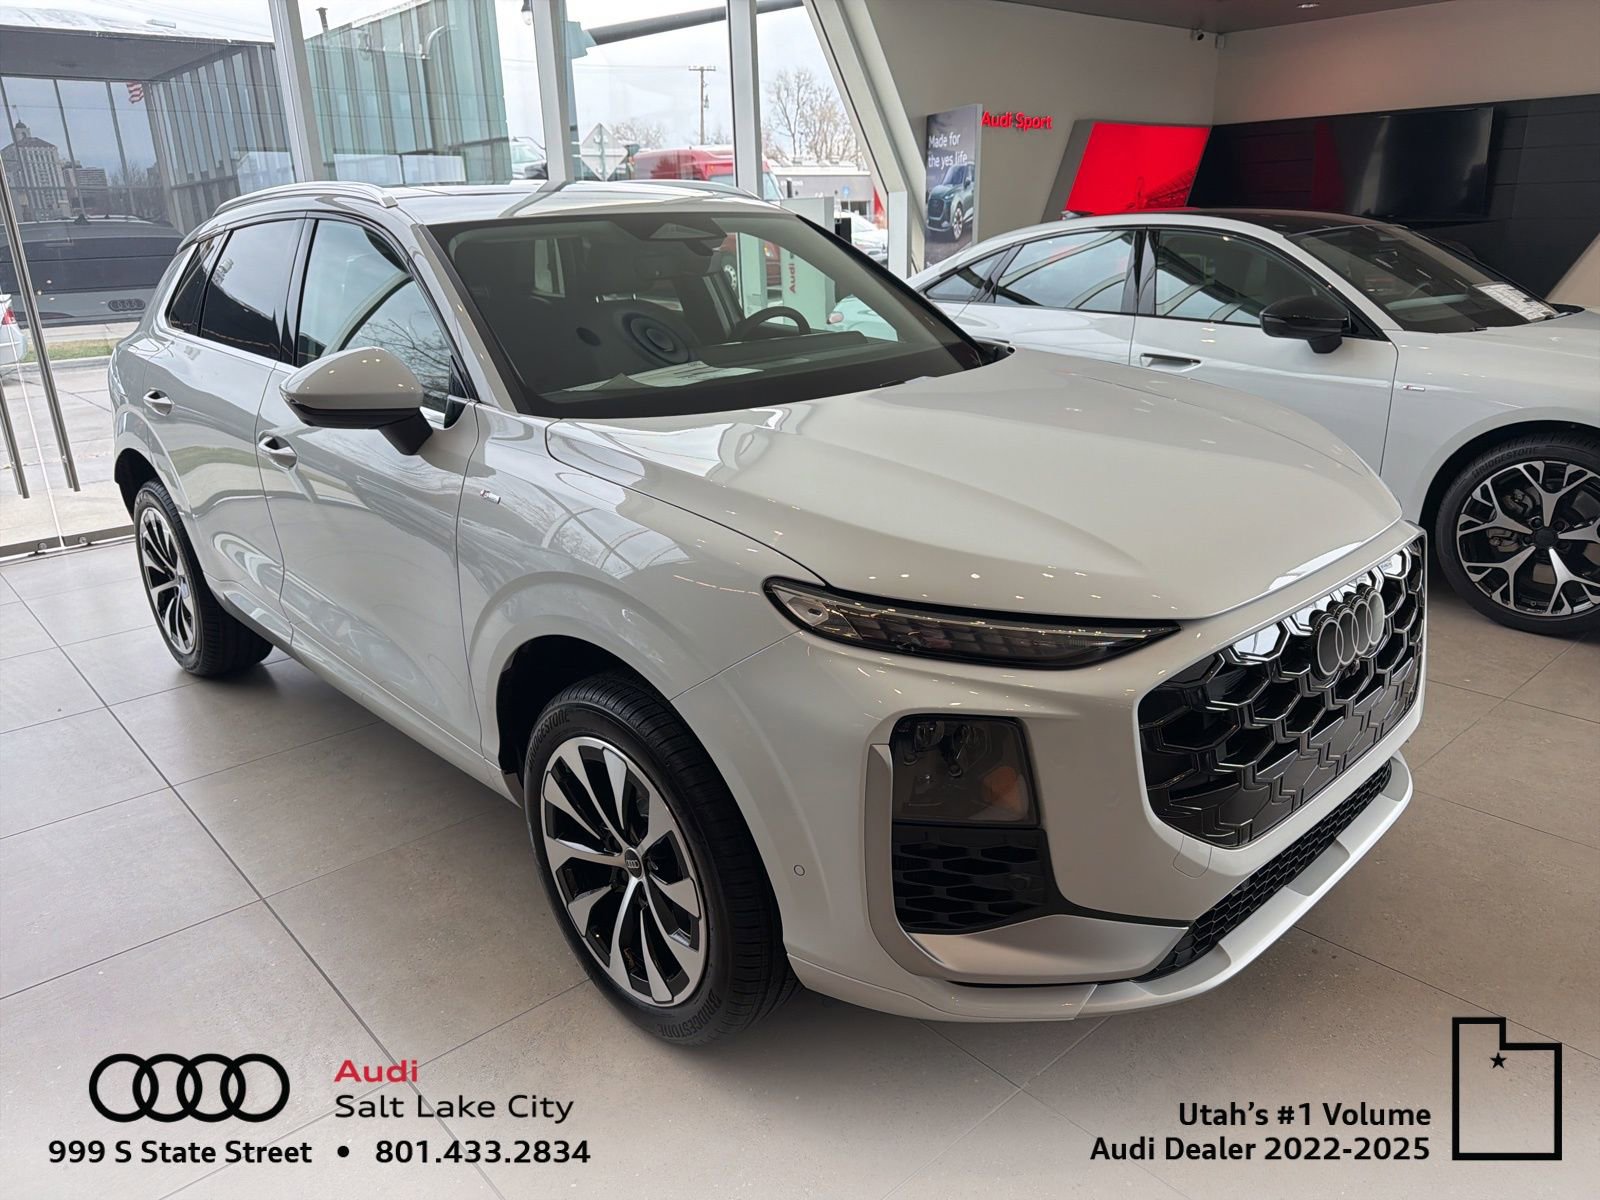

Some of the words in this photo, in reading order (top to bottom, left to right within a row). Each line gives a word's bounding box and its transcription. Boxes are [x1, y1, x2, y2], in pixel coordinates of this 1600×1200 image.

[981, 111, 1013, 128] Audi
[1015, 112, 1053, 131] Sport
[928, 133, 948, 148] Made
[949, 131, 961, 146] for
[928, 153, 940, 168] the
[940, 155, 953, 170] yes
[788, 263, 796, 294] Audi
